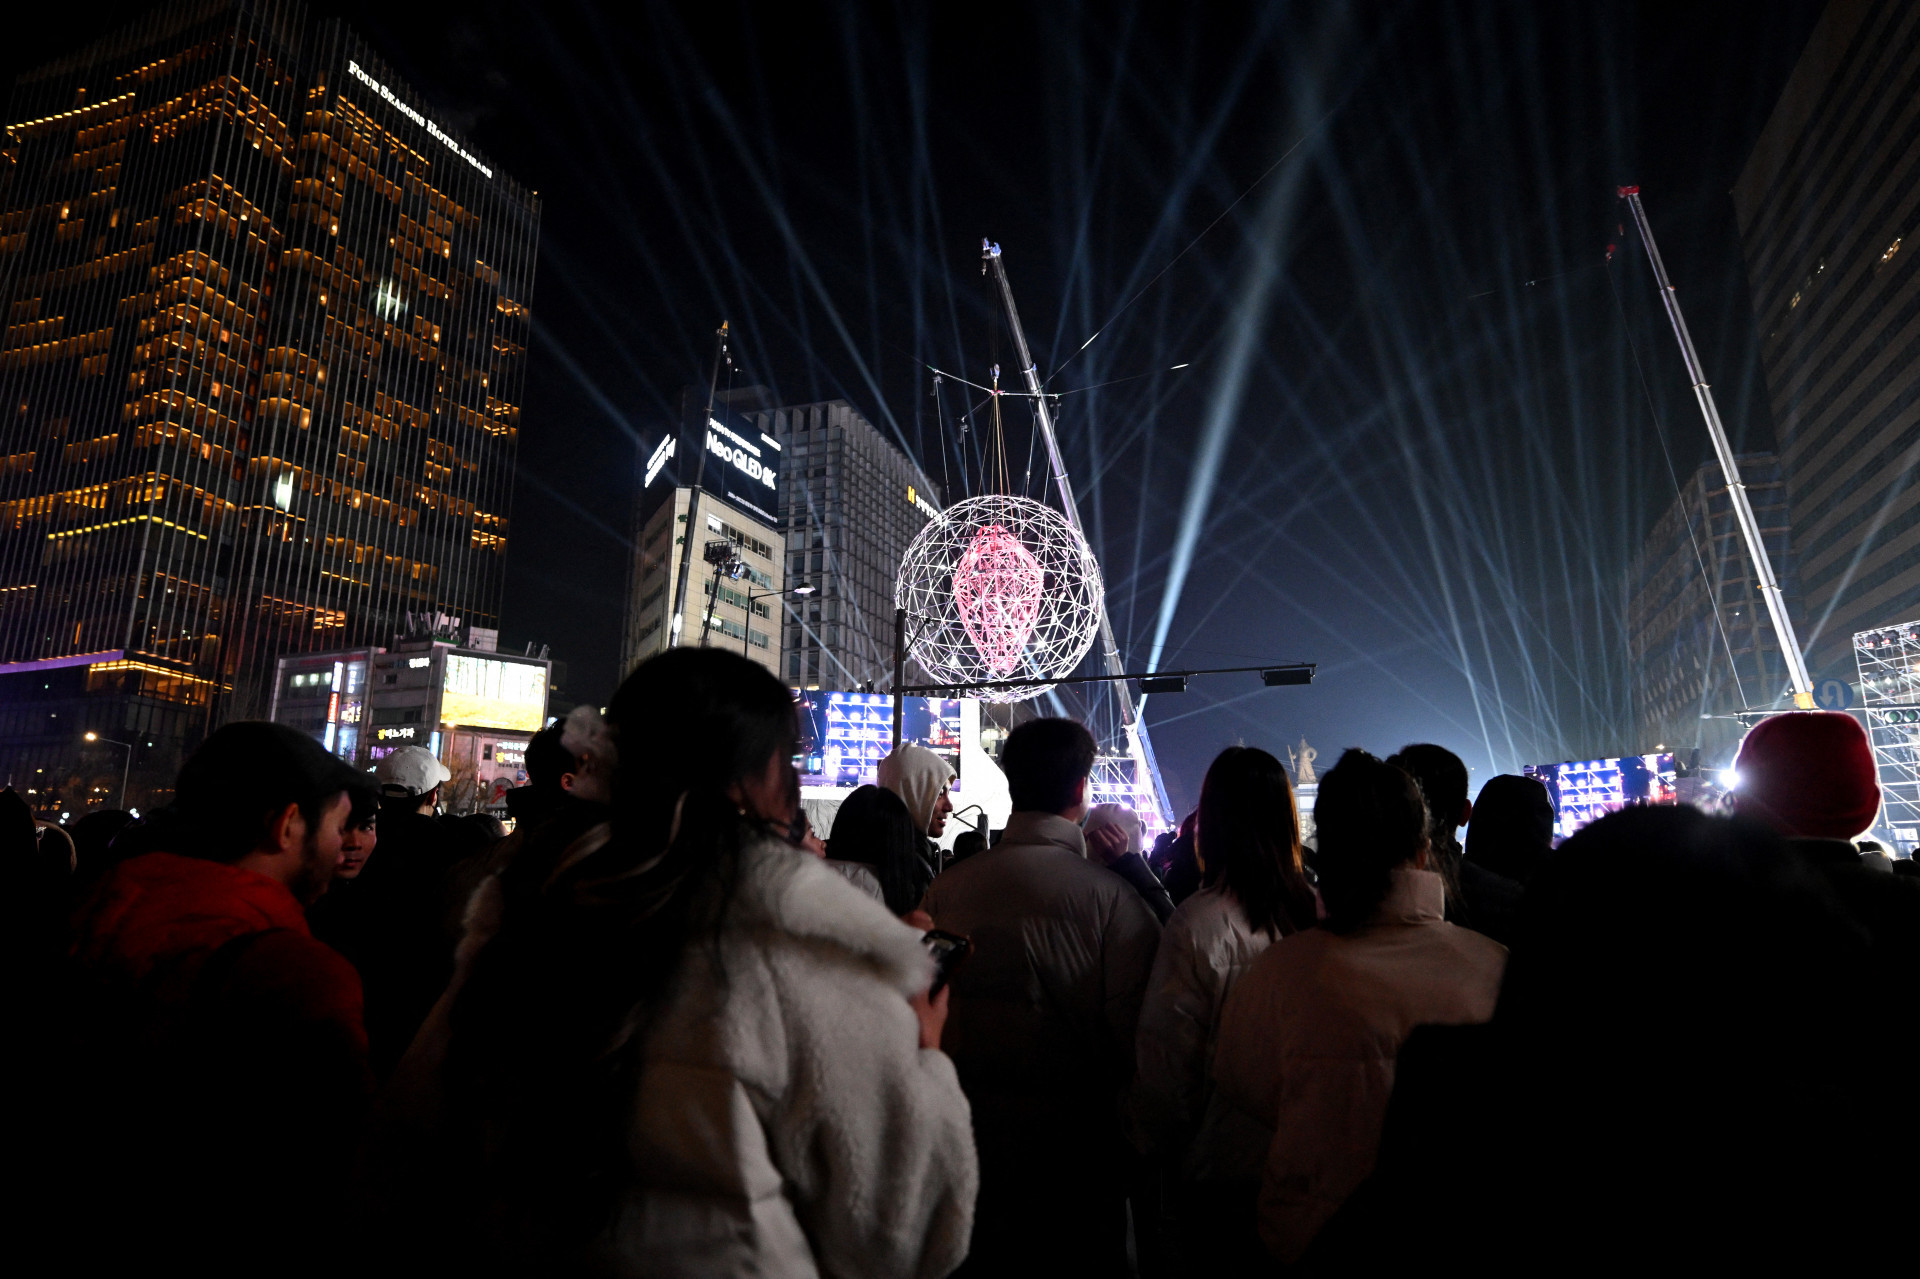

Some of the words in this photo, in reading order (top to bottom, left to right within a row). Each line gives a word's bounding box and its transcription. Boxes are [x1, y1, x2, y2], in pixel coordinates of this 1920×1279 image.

[348, 60, 380, 93] FOUR
[380, 85, 426, 127] SEASONS
[427, 119, 460, 155] HOTEL
[706, 430, 733, 462] Neo
[732, 449, 763, 480] QLED
[762, 466, 777, 491] 8K
